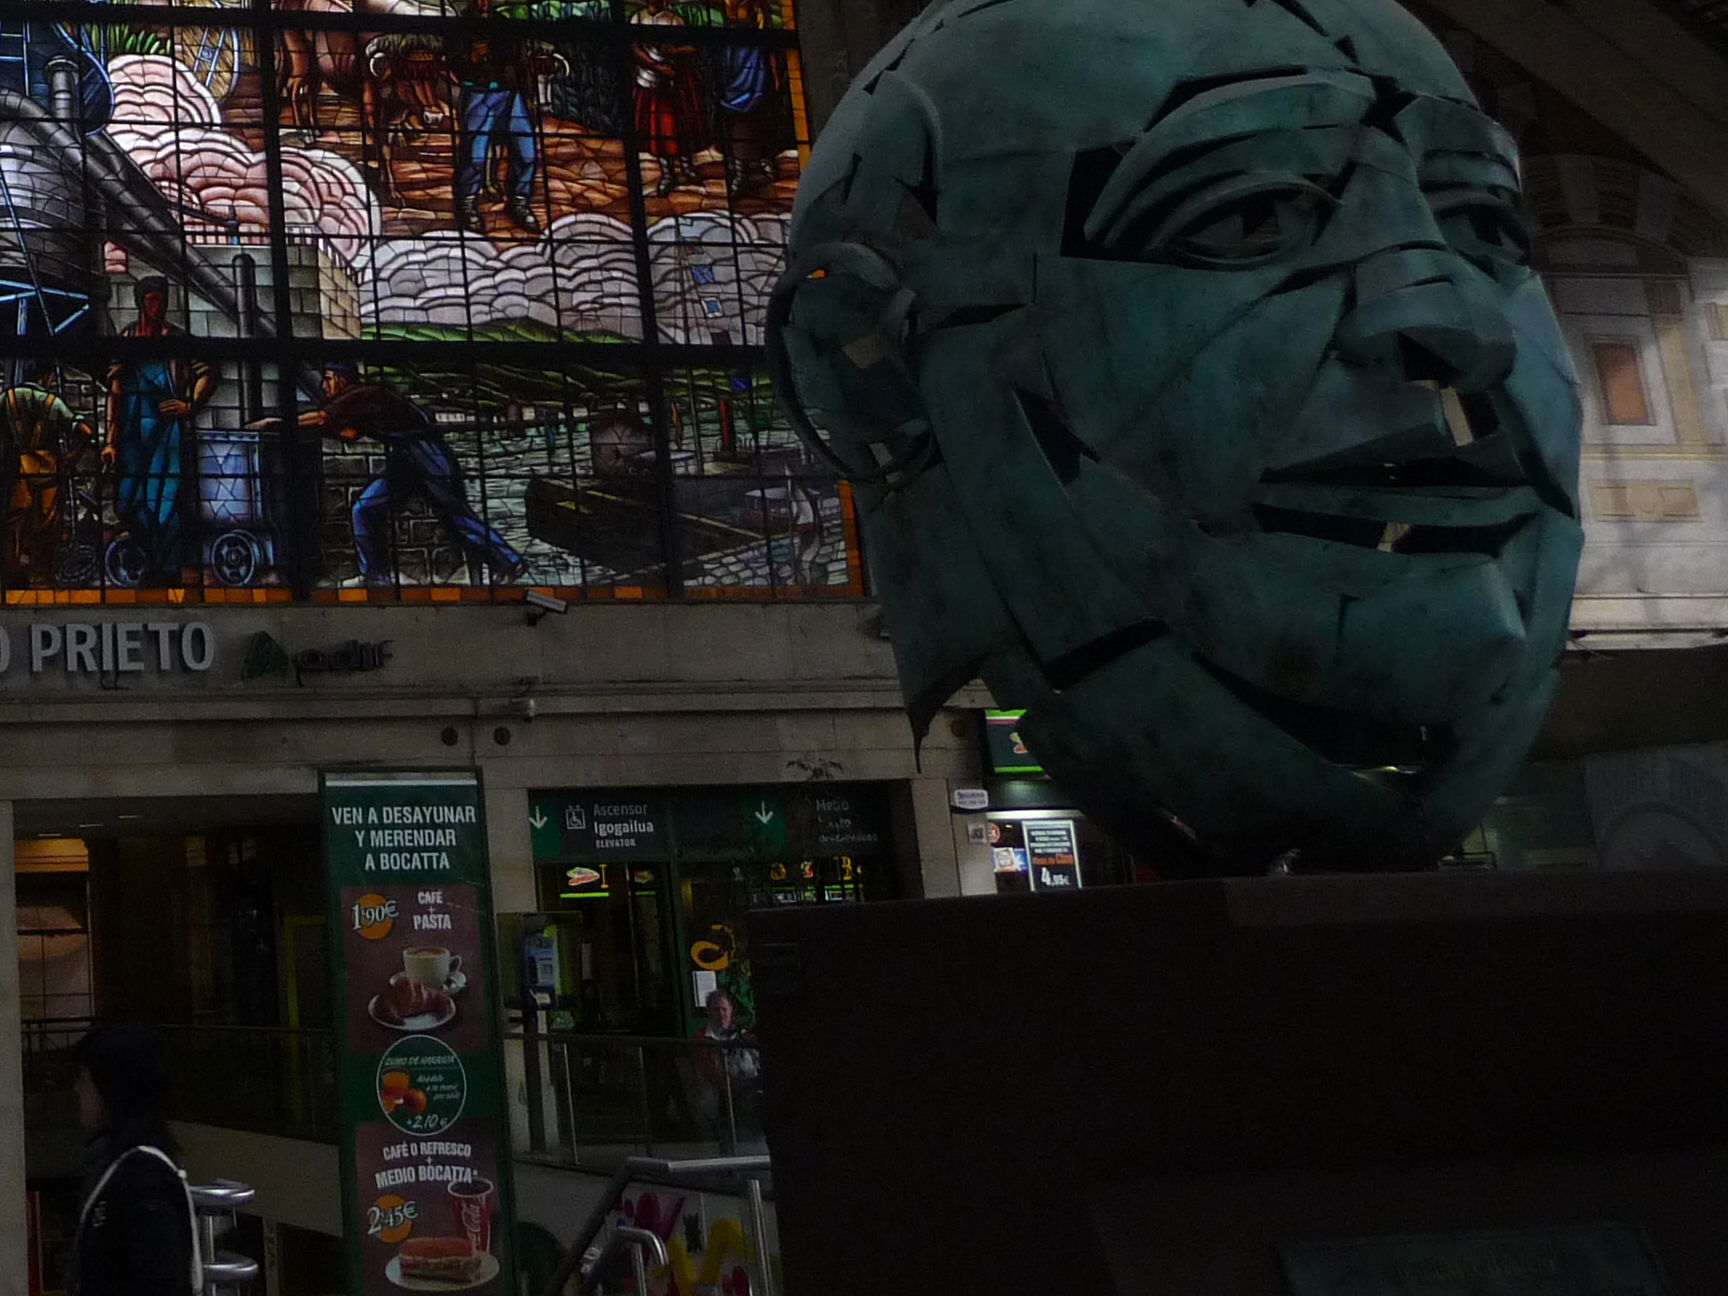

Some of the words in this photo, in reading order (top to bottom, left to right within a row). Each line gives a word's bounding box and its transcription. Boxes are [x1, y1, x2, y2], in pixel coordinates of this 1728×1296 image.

[30, 620, 216, 674] PRIETO
[331, 806, 363, 825] VEN
[367, 806, 379, 825] A
[383, 805, 477, 824] DESAYUNAR
[592, 802, 649, 817] Ascensor
[355, 830, 365, 848] Y
[370, 828, 457, 847] MERENDAR
[593, 818, 655, 838] Igogailua
[594, 838, 637, 849] ELEVATOR
[364, 853, 376, 871] A
[380, 851, 451, 871] BOCATTA
[412, 913, 452, 930] PASTA
[382, 1140, 409, 1161] CAFÉ
[410, 1142, 419, 1157] O
[421, 1141, 472, 1158] REFRESCO
[374, 1166, 416, 1189] MEDIO
